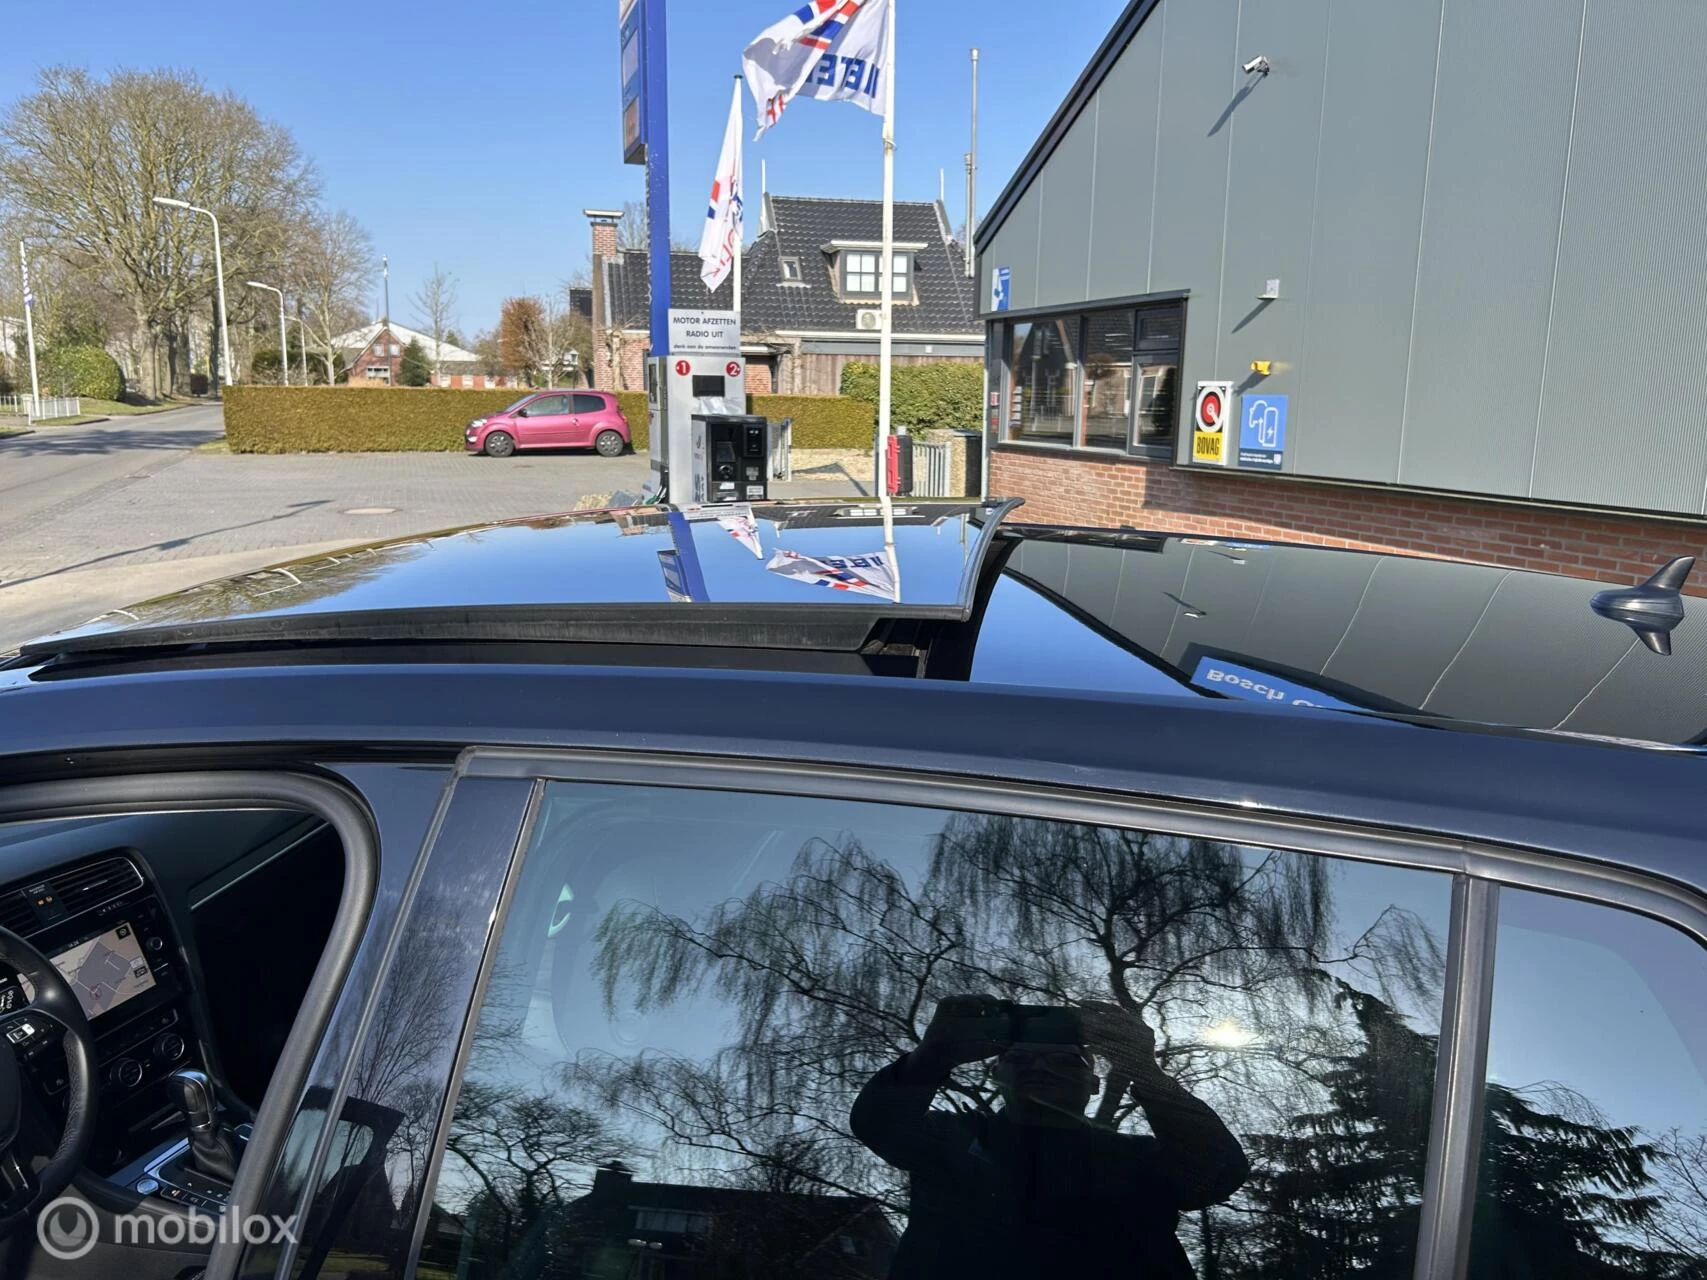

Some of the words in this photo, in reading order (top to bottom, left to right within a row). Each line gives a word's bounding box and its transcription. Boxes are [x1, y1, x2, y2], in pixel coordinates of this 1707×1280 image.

[681, 362, 687, 374] 1
[729, 363, 738, 375] 2
[1196, 436, 1220, 455] BOVAG
